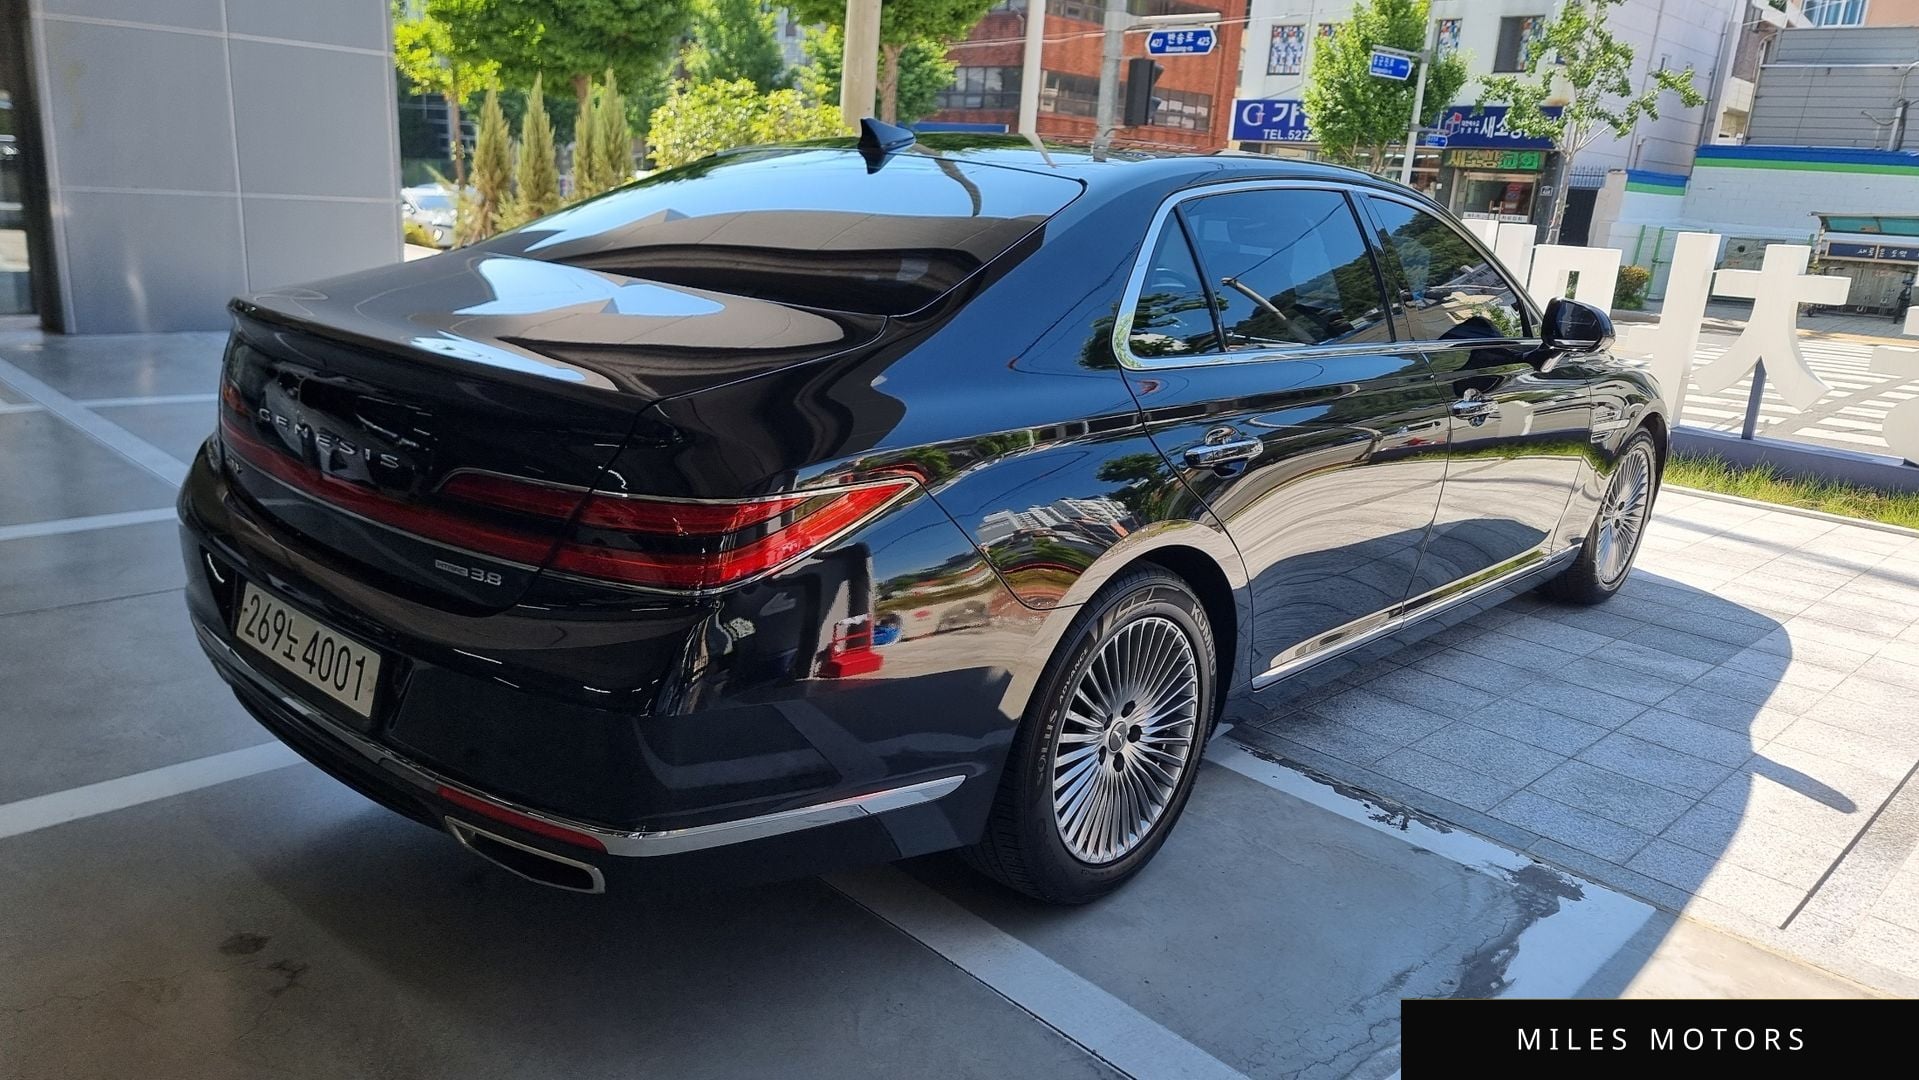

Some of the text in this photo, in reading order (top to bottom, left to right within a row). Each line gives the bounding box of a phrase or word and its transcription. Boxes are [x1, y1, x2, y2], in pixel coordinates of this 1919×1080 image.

[1167, 31, 1195, 45] 반송로
[259, 408, 400, 470] GENESIS
[471, 566, 502, 586] 3.8
[1191, 602, 1218, 677] KUMHO
[1058, 647, 1089, 705] ADVANCE
